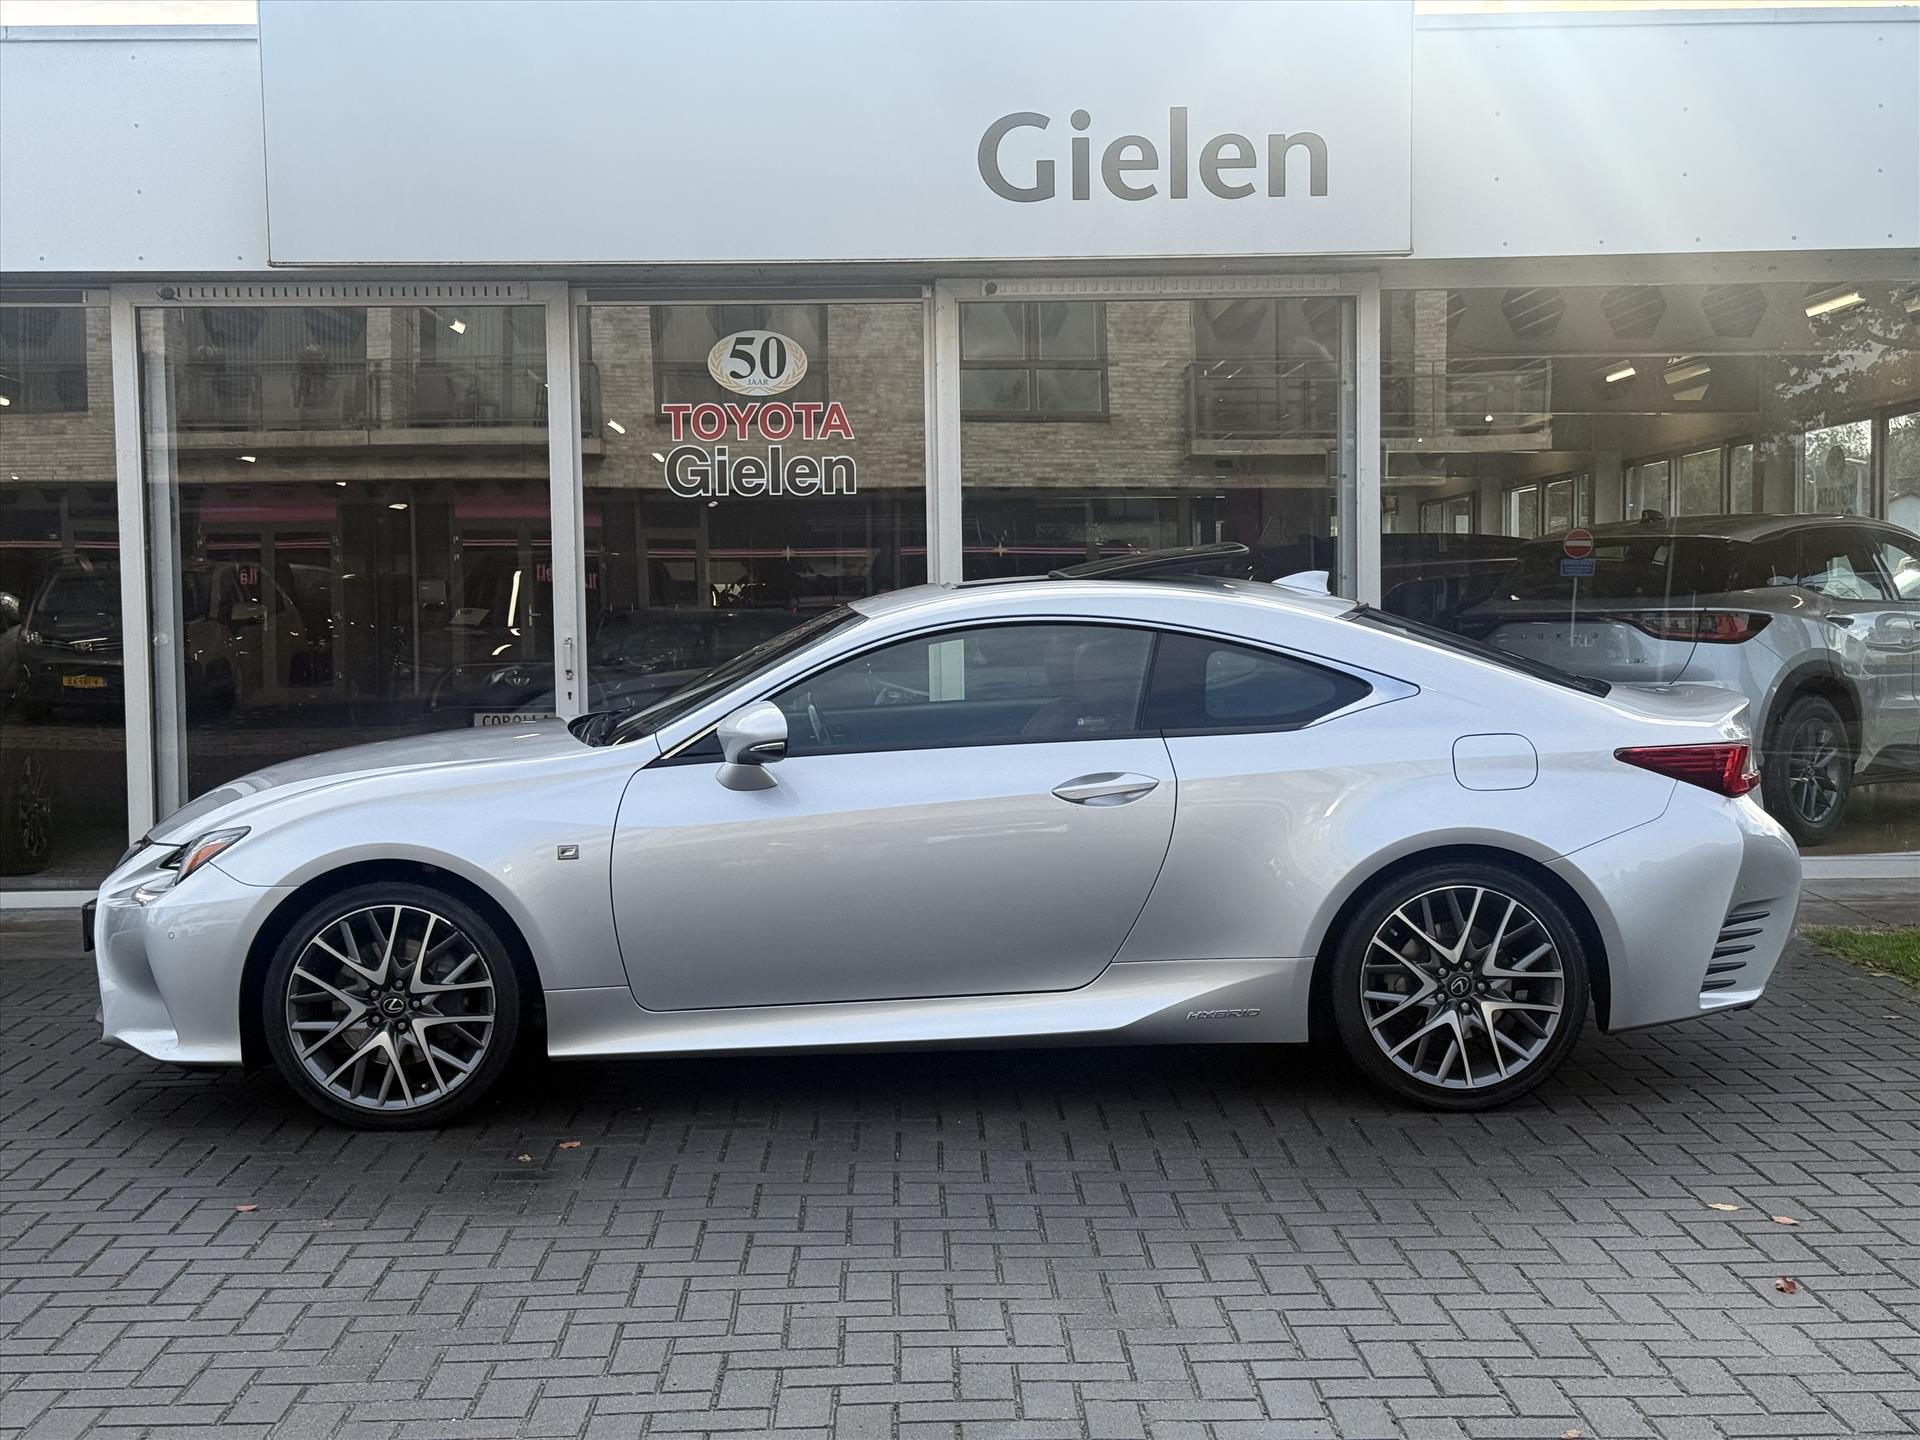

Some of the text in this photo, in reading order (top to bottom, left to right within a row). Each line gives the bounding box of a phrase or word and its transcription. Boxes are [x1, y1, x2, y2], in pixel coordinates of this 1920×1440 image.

[978, 106, 1329, 203] Gielen
[729, 336, 787, 380] 50
[747, 378, 769, 386] JAAR
[662, 402, 855, 441] TOYOTA
[664, 445, 857, 498] Gielen
[1186, 1008, 1261, 1020] HYBRID
